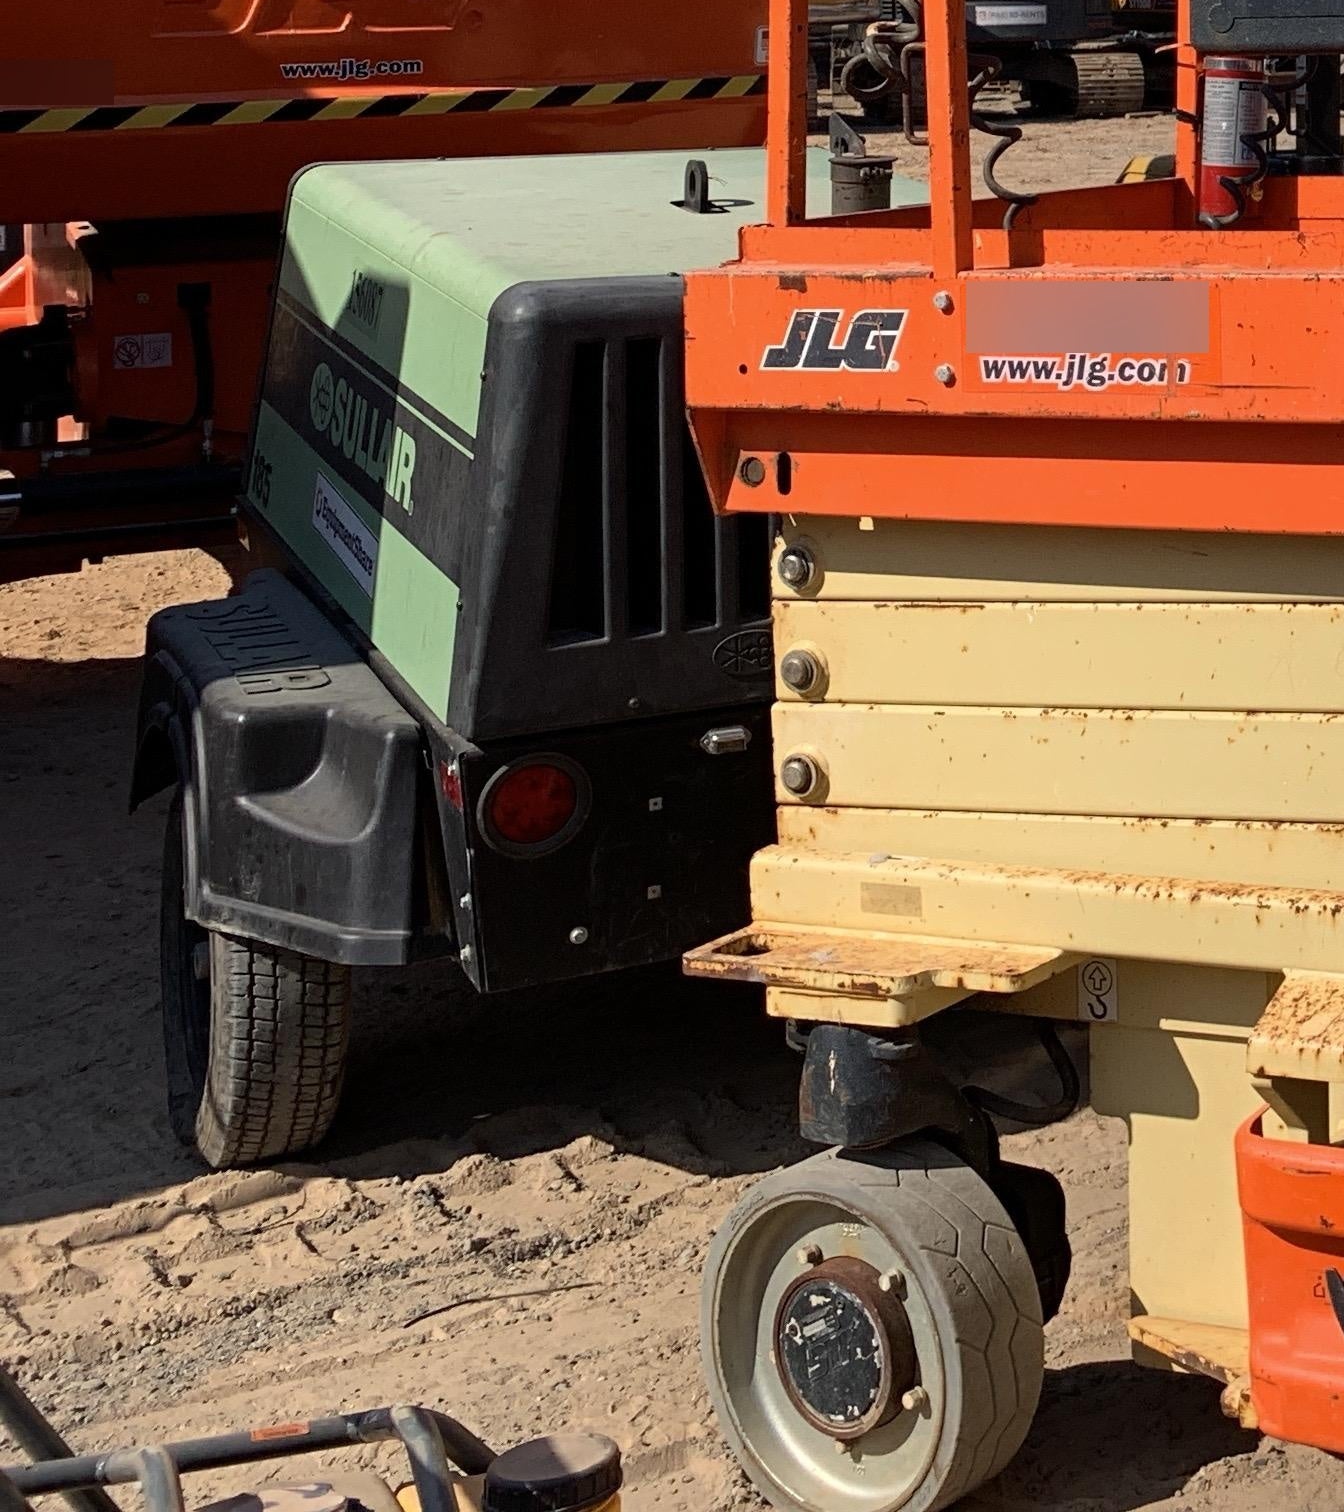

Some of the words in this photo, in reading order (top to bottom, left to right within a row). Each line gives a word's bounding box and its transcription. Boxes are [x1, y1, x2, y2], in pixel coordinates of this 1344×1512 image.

[280, 58, 423, 80] www.jlg.com
[758, 308, 909, 372] JLG
[979, 353, 1191, 390] www.jlg.com
[331, 377, 417, 516] SULLAIR
